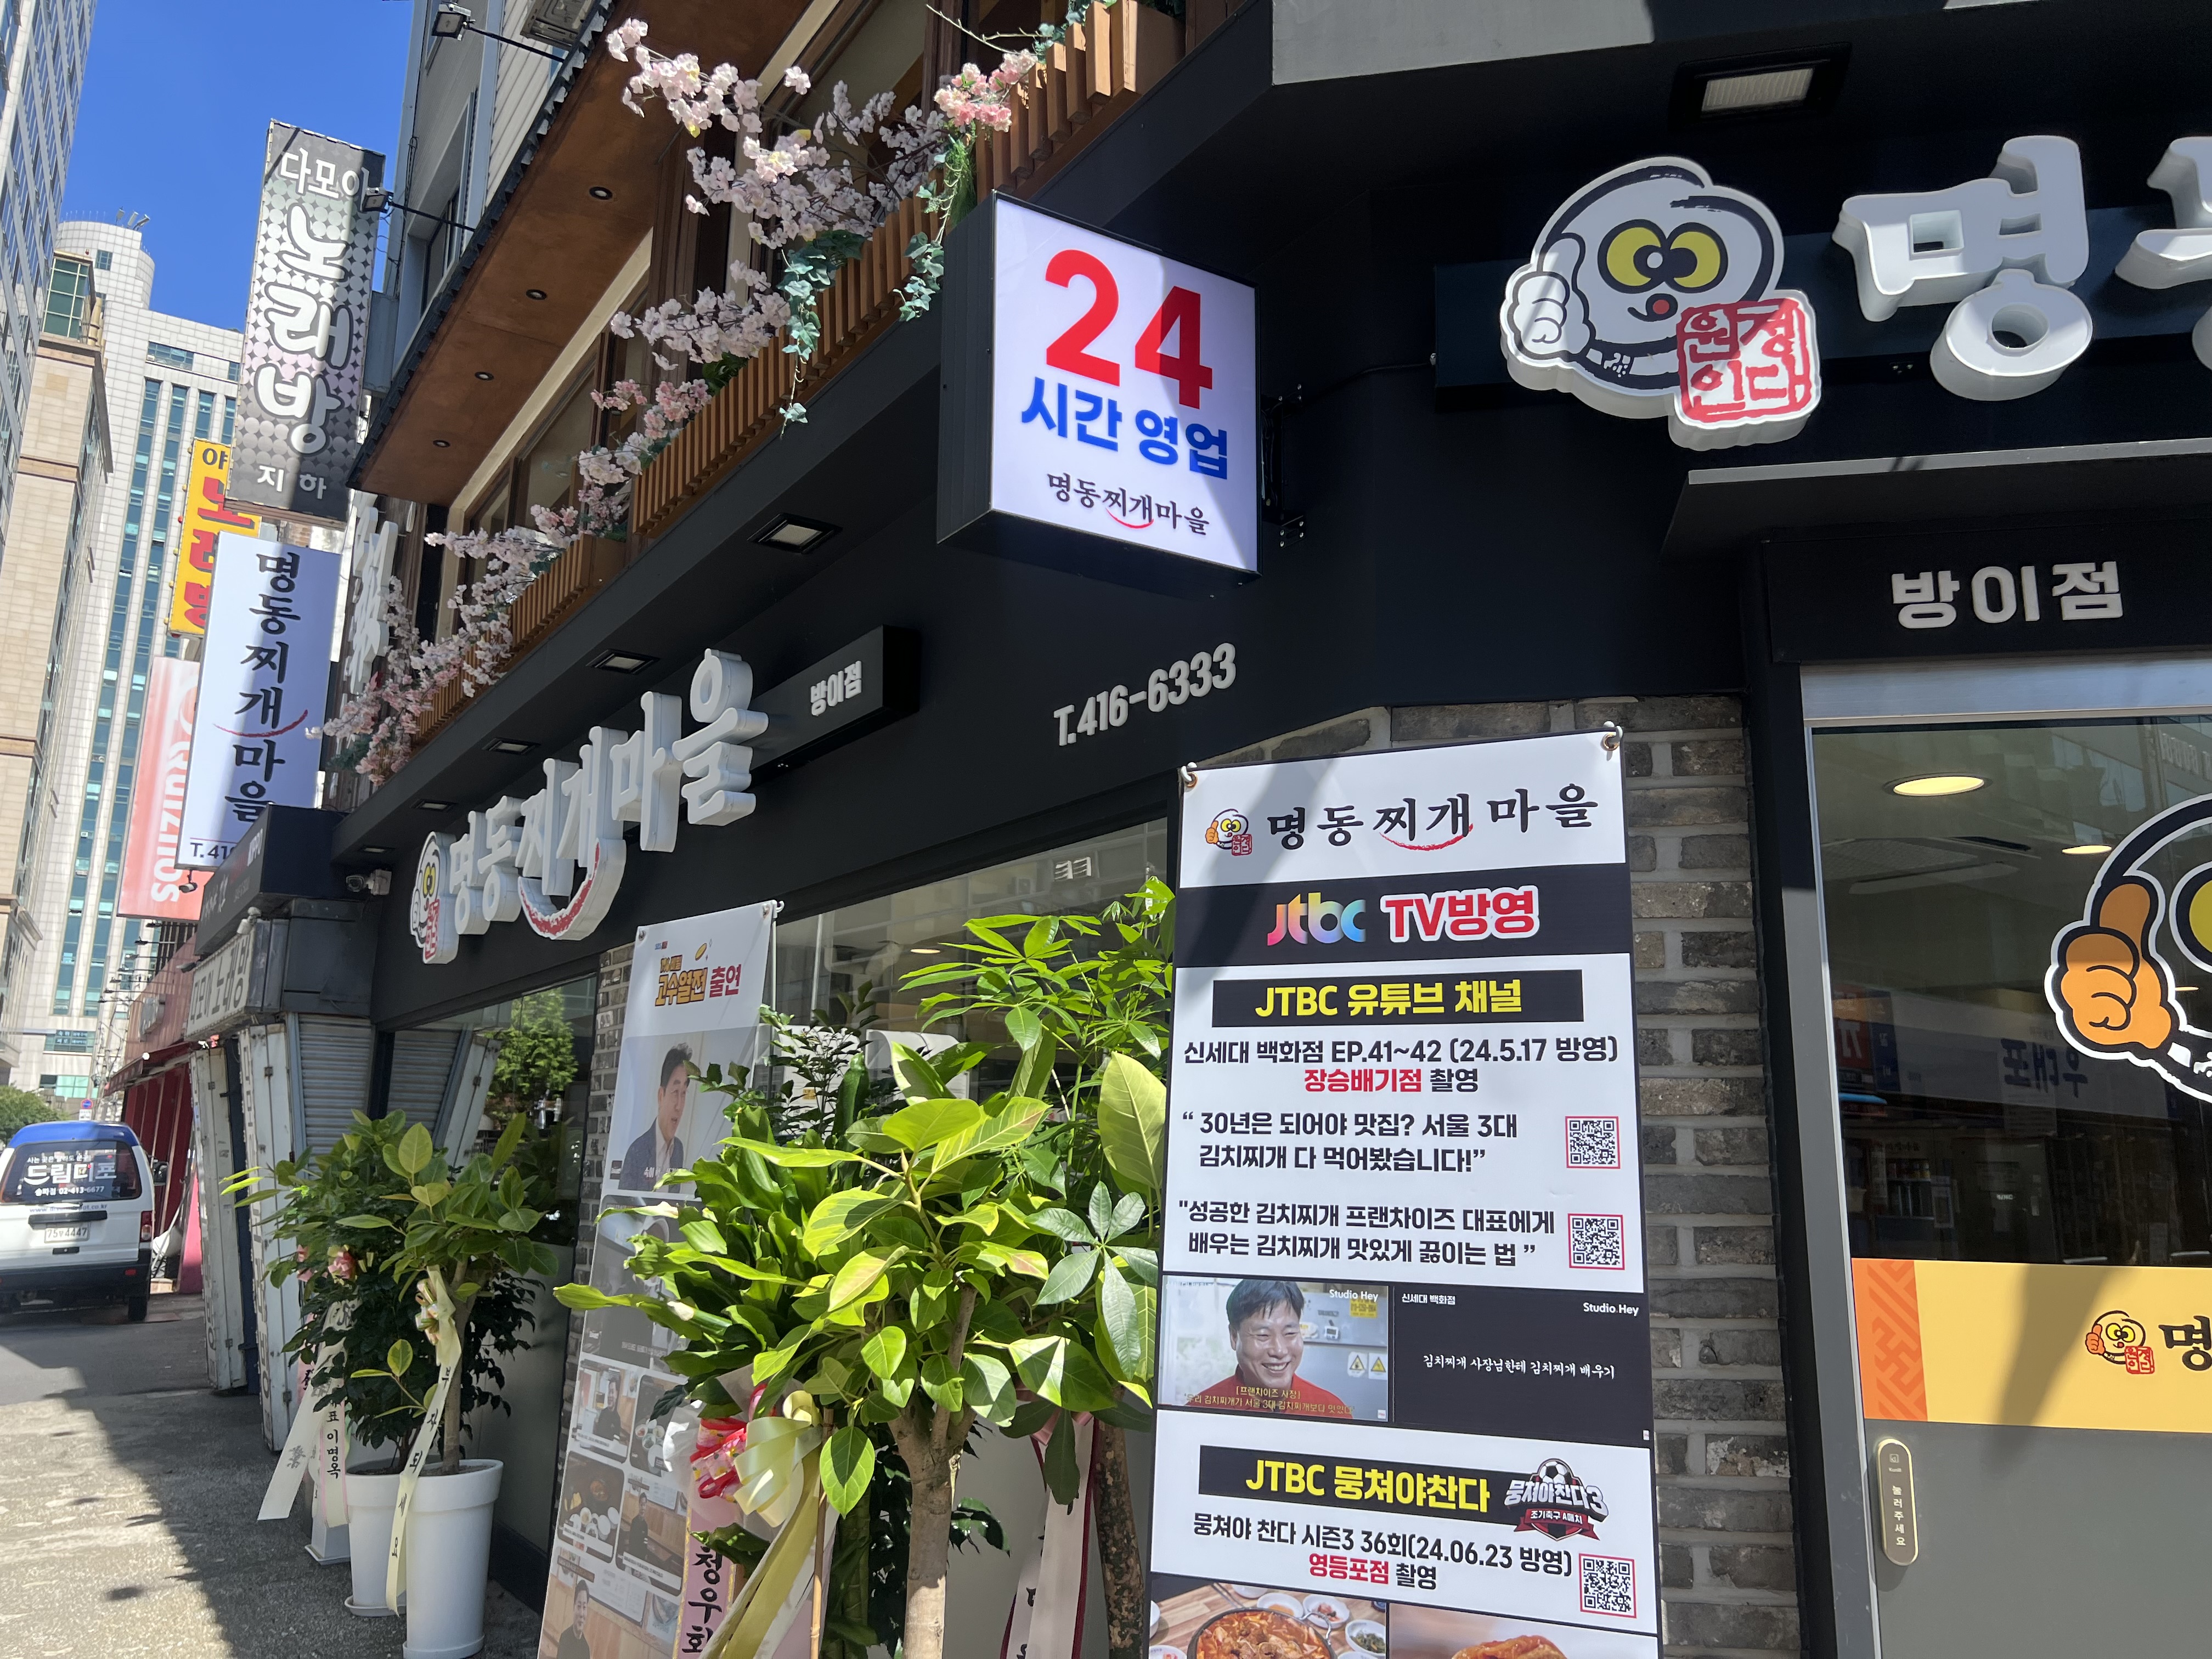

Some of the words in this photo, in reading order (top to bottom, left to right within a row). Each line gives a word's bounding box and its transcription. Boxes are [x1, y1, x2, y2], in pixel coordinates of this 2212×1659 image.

[255, 203, 354, 455] 노래방
[1045, 249, 1212, 410] 24
[1022, 376, 1122, 452] 시간
[1135, 409, 1228, 480] 영업
[1047, 472, 1210, 535] 명동찌개마을
[1892, 561, 2124, 629] 방이점
[224, 551, 301, 823] 명동찌개마을
[810, 660, 862, 716] 방이점
[1054, 642, 1237, 747] T.416-6333
[450, 648, 768, 934] 명동찌개마을
[1267, 783, 1599, 850] 명동찌개마을
[1267, 892, 1366, 947] jtbc
[1382, 887, 1538, 941] TV방영
[654, 967, 708, 1007] 고수열전
[709, 964, 742, 998] 출연
[1254, 985, 1338, 1018] JTBC
[1347, 981, 1445, 1017] 유튜브
[1455, 979, 1523, 1014] 채널
[1184, 1040, 1249, 1064] 신세대
[1257, 1040, 1323, 1063] 백화점
[1331, 1039, 1442, 1063] EP.41~42
[1450, 1037, 1547, 1063] (24.5.17
[1556, 1035, 1618, 1062] 방영)
[1305, 1068, 1422, 1092] 장승배기점
[1430, 1068, 1479, 1092] 촬영
[1200, 1111, 1272, 1135] 30년은
[1280, 1113, 1347, 1136] 되어야
[1355, 1113, 1415, 1137] 맛집?
[1423, 1114, 1470, 1137] 서울
[1477, 1114, 1517, 1138] 3대
[24, 1162, 117, 1185] 드림디포
[1200, 1144, 1287, 1169] 김치찌개
[1295, 1146, 1316, 1170] 다
[1324, 1147, 1486, 1173] 먹어봤습니다!”
[59, 1186, 105, 1195] 02-413-6677
[1179, 1200, 1250, 1223] "성공한
[1256, 1203, 1339, 1227] 김치찌개
[1346, 1205, 1455, 1231] 프랜차이즈
[1463, 1209, 1555, 1234] 대표에게
[1189, 1232, 1250, 1256] 배우는
[1257, 1234, 1340, 1260] 김치찌개
[1348, 1238, 1412, 1262] 맛있게
[1419, 1240, 1487, 1266] 끓이는
[1494, 1243, 1516, 1267] 법
[1329, 1289, 1358, 1299] Studio
[1361, 1291, 1379, 1302] Hey
[1402, 1293, 1427, 1304] 신세대
[1430, 1294, 1456, 1306] 백화점
[1423, 1354, 1467, 1370] 김치찌개
[1470, 1357, 1526, 1374] 사장님한테
[1530, 1361, 1576, 1377] 김치찌개
[1579, 1363, 1615, 1380] 배우기
[1205, 1395, 1243, 1408] 김치찌개가
[1245, 1397, 1261, 1408] 서울
[1262, 1398, 1276, 1411] 3대
[1279, 1400, 1325, 1413] 김치찌개보다
[1245, 1460, 1325, 1496] JTBC
[1334, 1465, 1491, 1513] 뭉쳐야찬다
[1530, 1510, 1561, 1520] 조기축구
[1892, 1485, 1906, 1547] 눌러주세요
[1194, 1513, 1252, 1540] 뭉쳐야
[1257, 1519, 1296, 1545] 찬다
[1302, 1524, 1354, 1551] 시즌3
[1361, 1530, 1513, 1569] 36회(24.06.23
[1520, 1546, 1572, 1577] 방영)
[1309, 1553, 1389, 1585] 영등포점
[1396, 1562, 1437, 1590] 촬영
